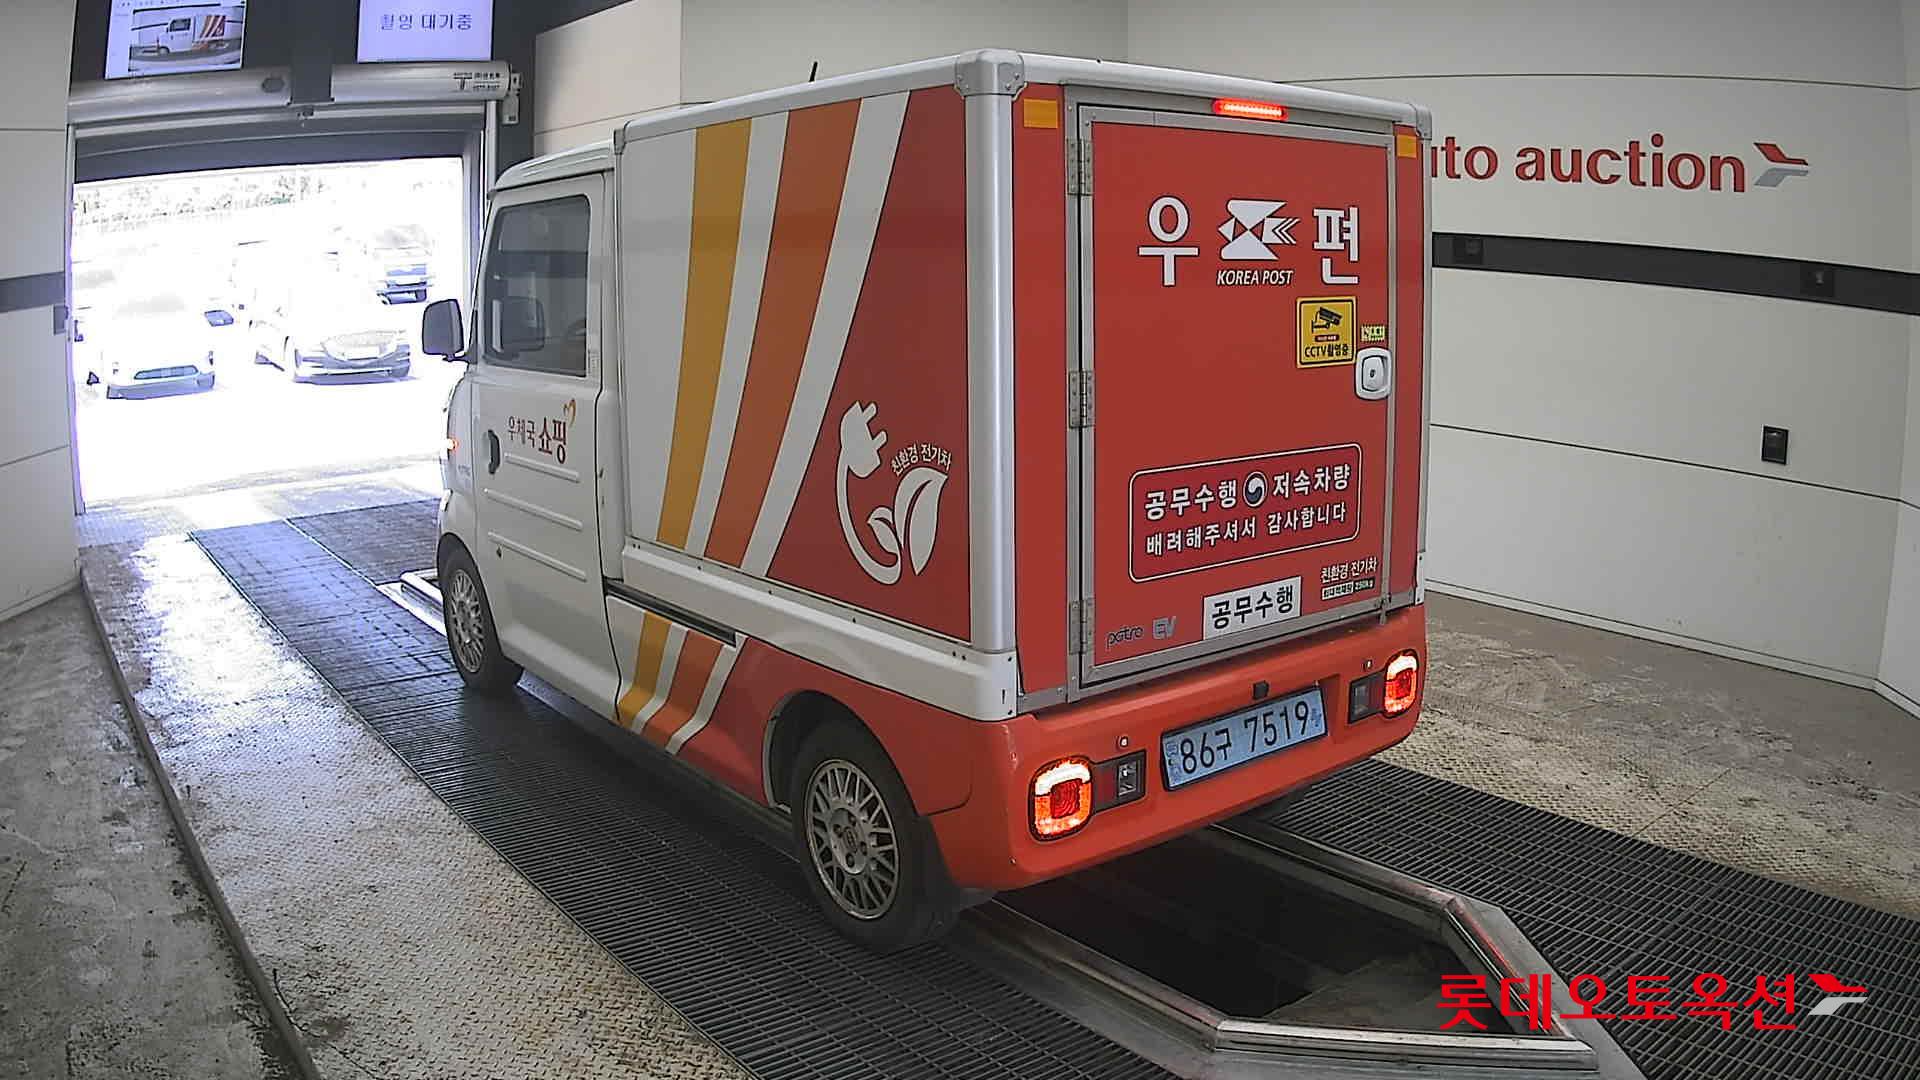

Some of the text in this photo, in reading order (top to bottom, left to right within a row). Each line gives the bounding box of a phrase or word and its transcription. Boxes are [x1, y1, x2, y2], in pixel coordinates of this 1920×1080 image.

[421, 13, 472, 31] 대기중
[1432, 133, 1745, 193] to auction
[1138, 196, 1359, 287] 우 편
[1217, 270, 1293, 286] KOREA POST
[508, 416, 568, 465] 우체국 쇼핑
[891, 443, 952, 476] 친환경 전기차
[1144, 463, 1350, 521] 공무수행 저속차량
[1146, 502, 1346, 557] 배려해주셔서 감사합니다
[1320, 556, 1377, 584] 친환경 전기차
[1152, 615, 1177, 640] EV
[1211, 584, 1294, 630] 공무수행
[1179, 700, 1309, 775] 86구 7519
